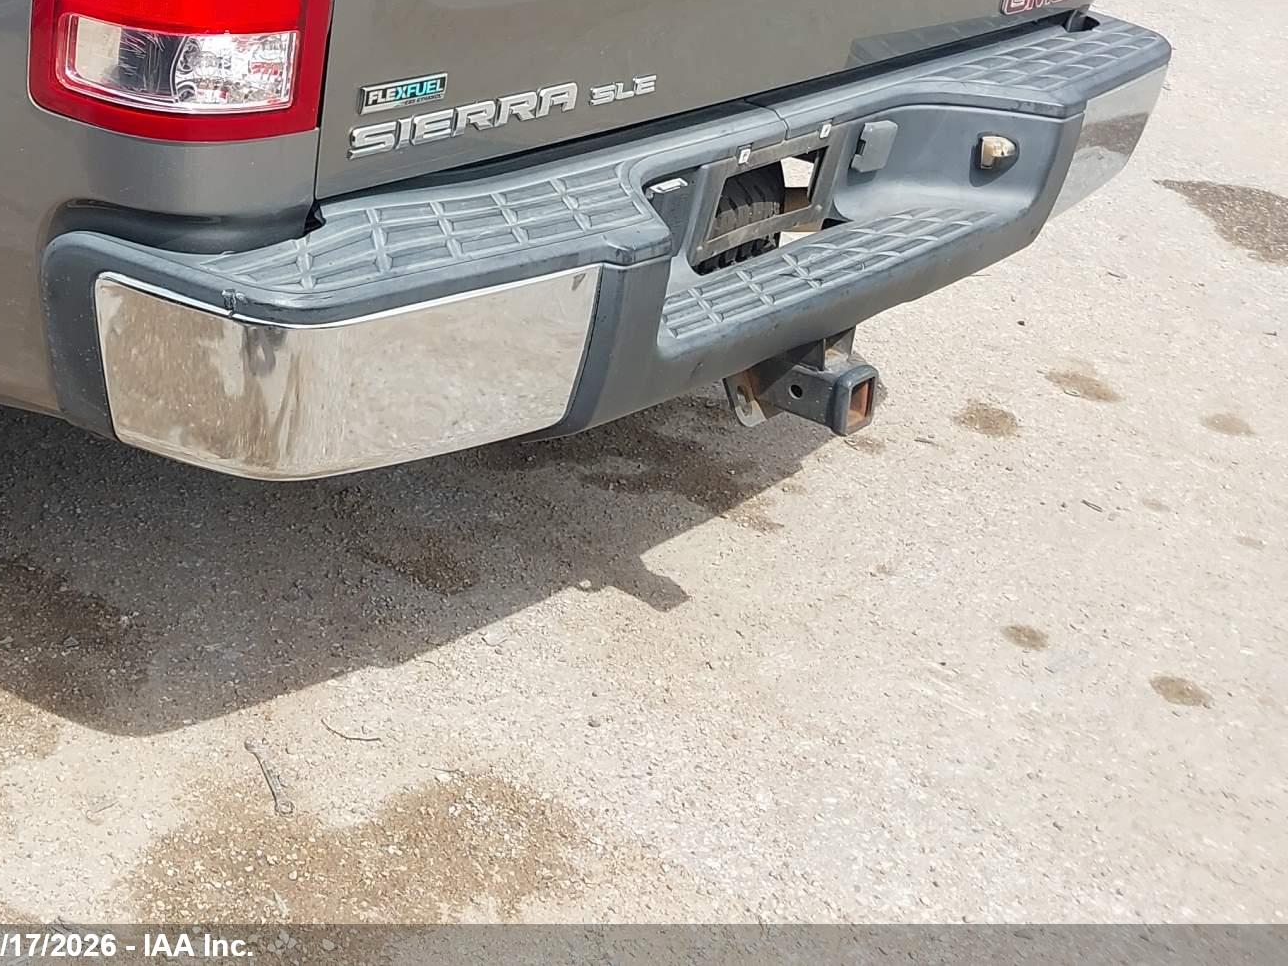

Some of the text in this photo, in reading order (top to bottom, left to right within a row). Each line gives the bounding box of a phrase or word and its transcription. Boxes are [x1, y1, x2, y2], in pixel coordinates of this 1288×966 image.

[347, 74, 657, 160] SIERRA SLE
[367, 79, 444, 105] FLEXFUEL
